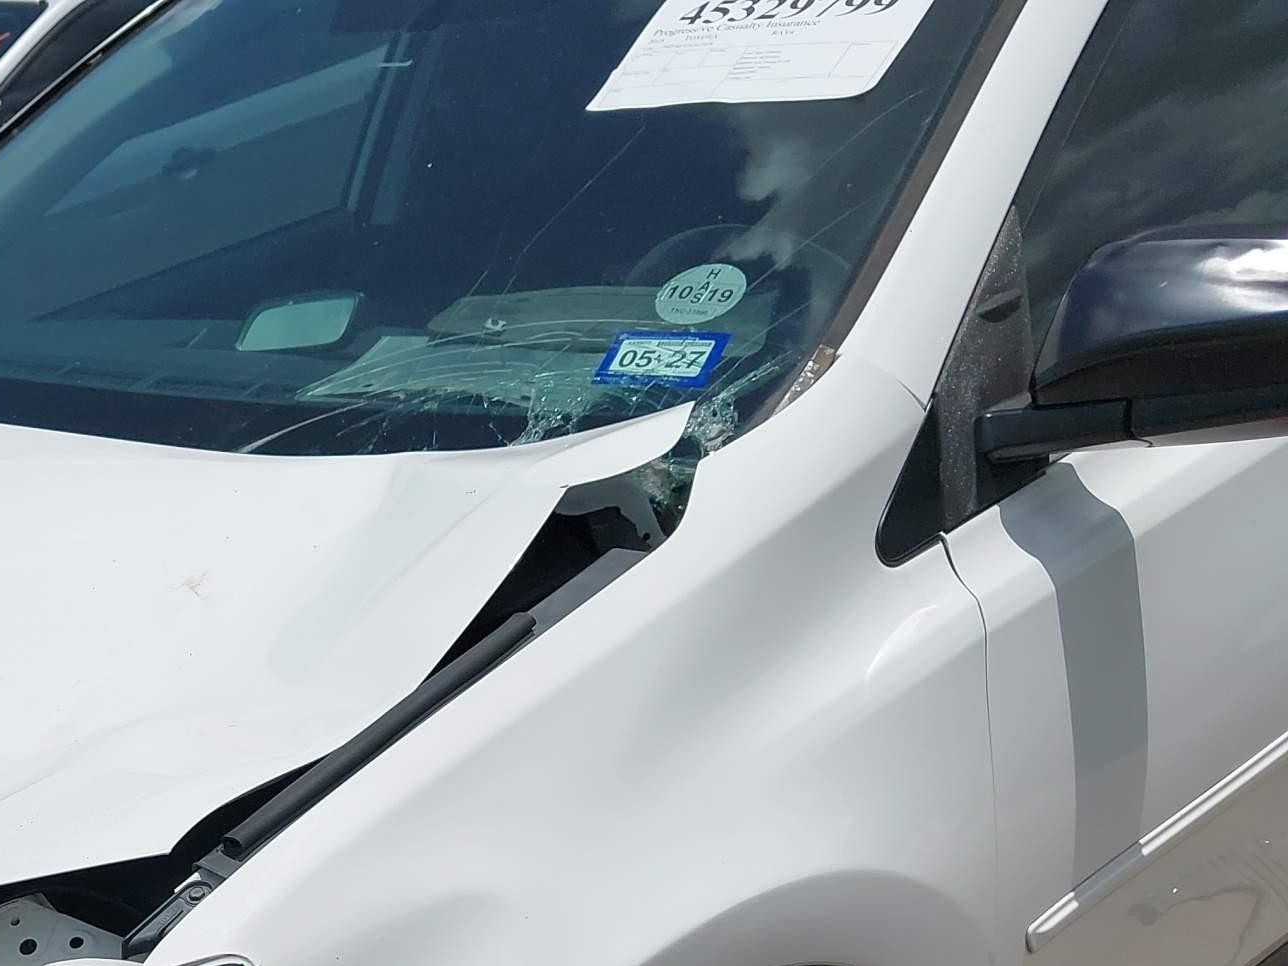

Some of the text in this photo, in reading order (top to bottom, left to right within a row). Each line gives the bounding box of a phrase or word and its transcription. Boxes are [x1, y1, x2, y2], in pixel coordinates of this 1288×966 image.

[716, 21, 761, 32] Casualty
[765, 20, 821, 28] Insurance
[668, 285, 734, 303] 10 19
[618, 350, 655, 368] 05
